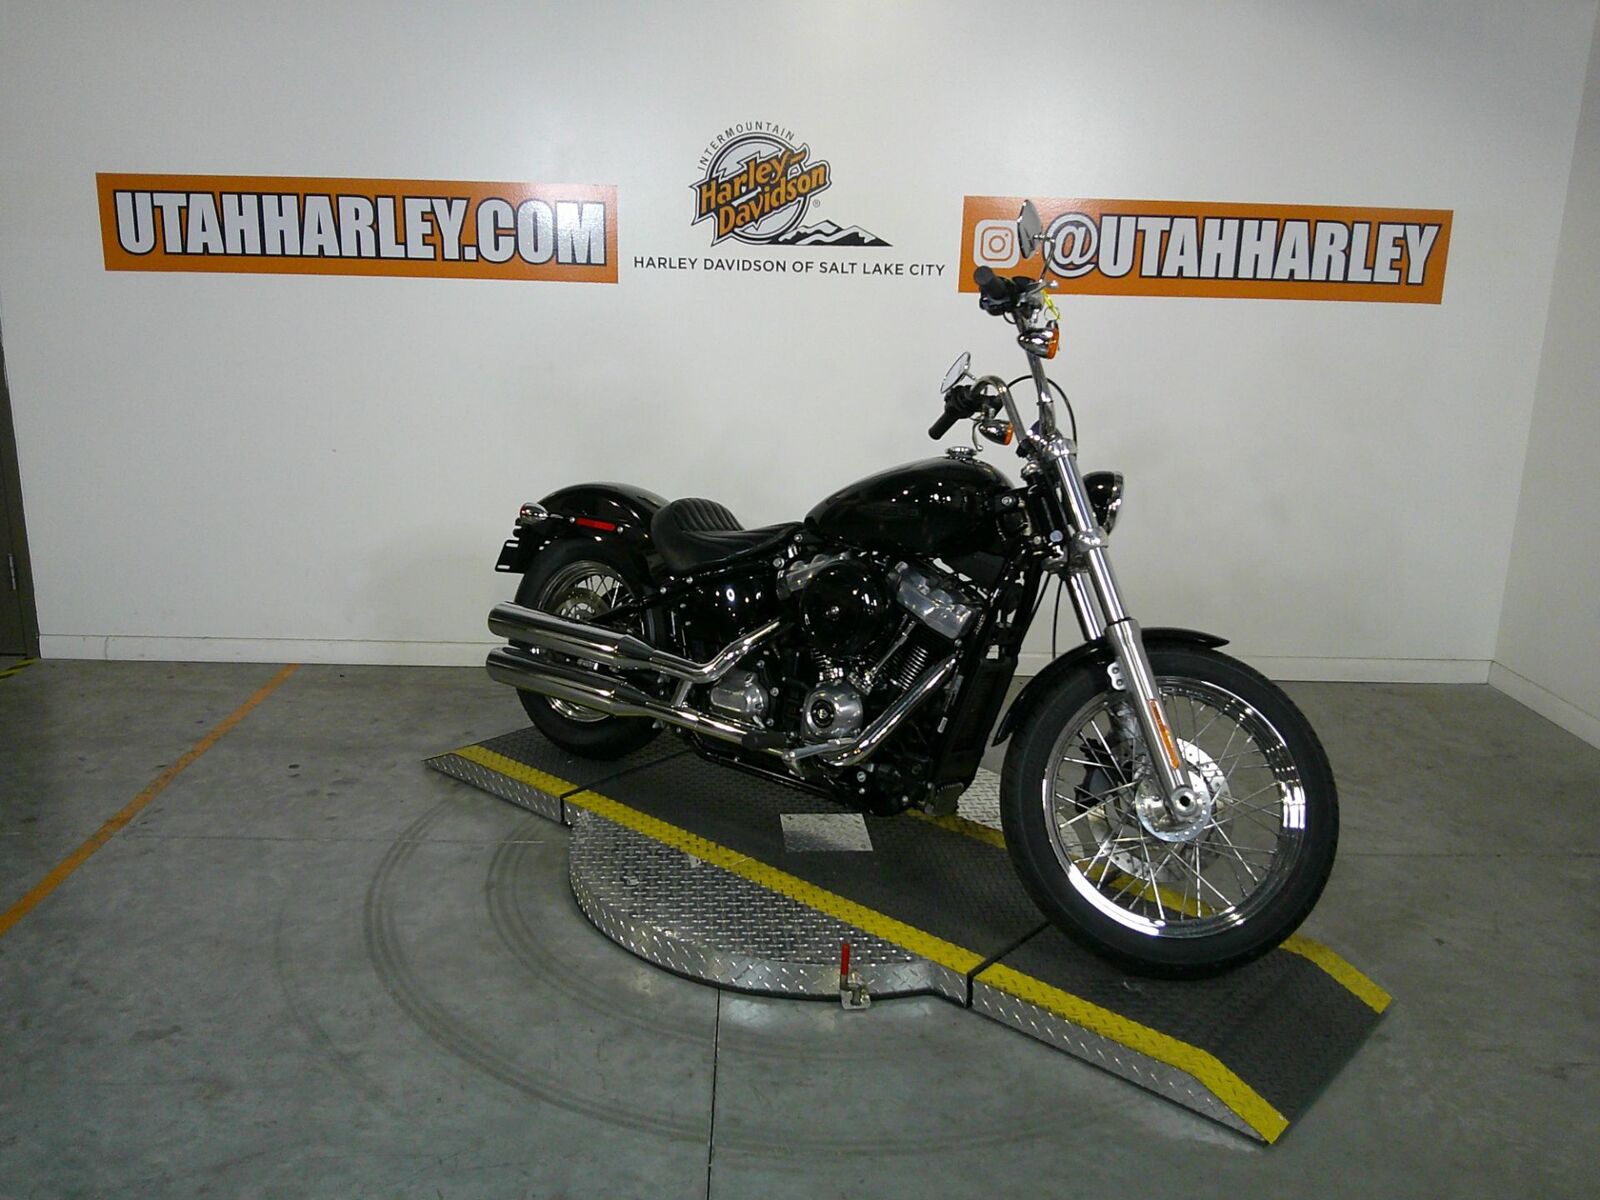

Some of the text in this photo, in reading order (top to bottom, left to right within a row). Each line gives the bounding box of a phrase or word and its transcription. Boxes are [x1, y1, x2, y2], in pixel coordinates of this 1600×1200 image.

[697, 121, 795, 171] INTERMOUNTAIN
[113, 189, 607, 267] UTAHHARLEY.COM
[717, 166, 827, 237] Davidson
[633, 256, 946, 276] HARLEY DAVIDSON OF SALT LAKE CITY
[1042, 211, 1444, 285] @UTAHHARLEY
